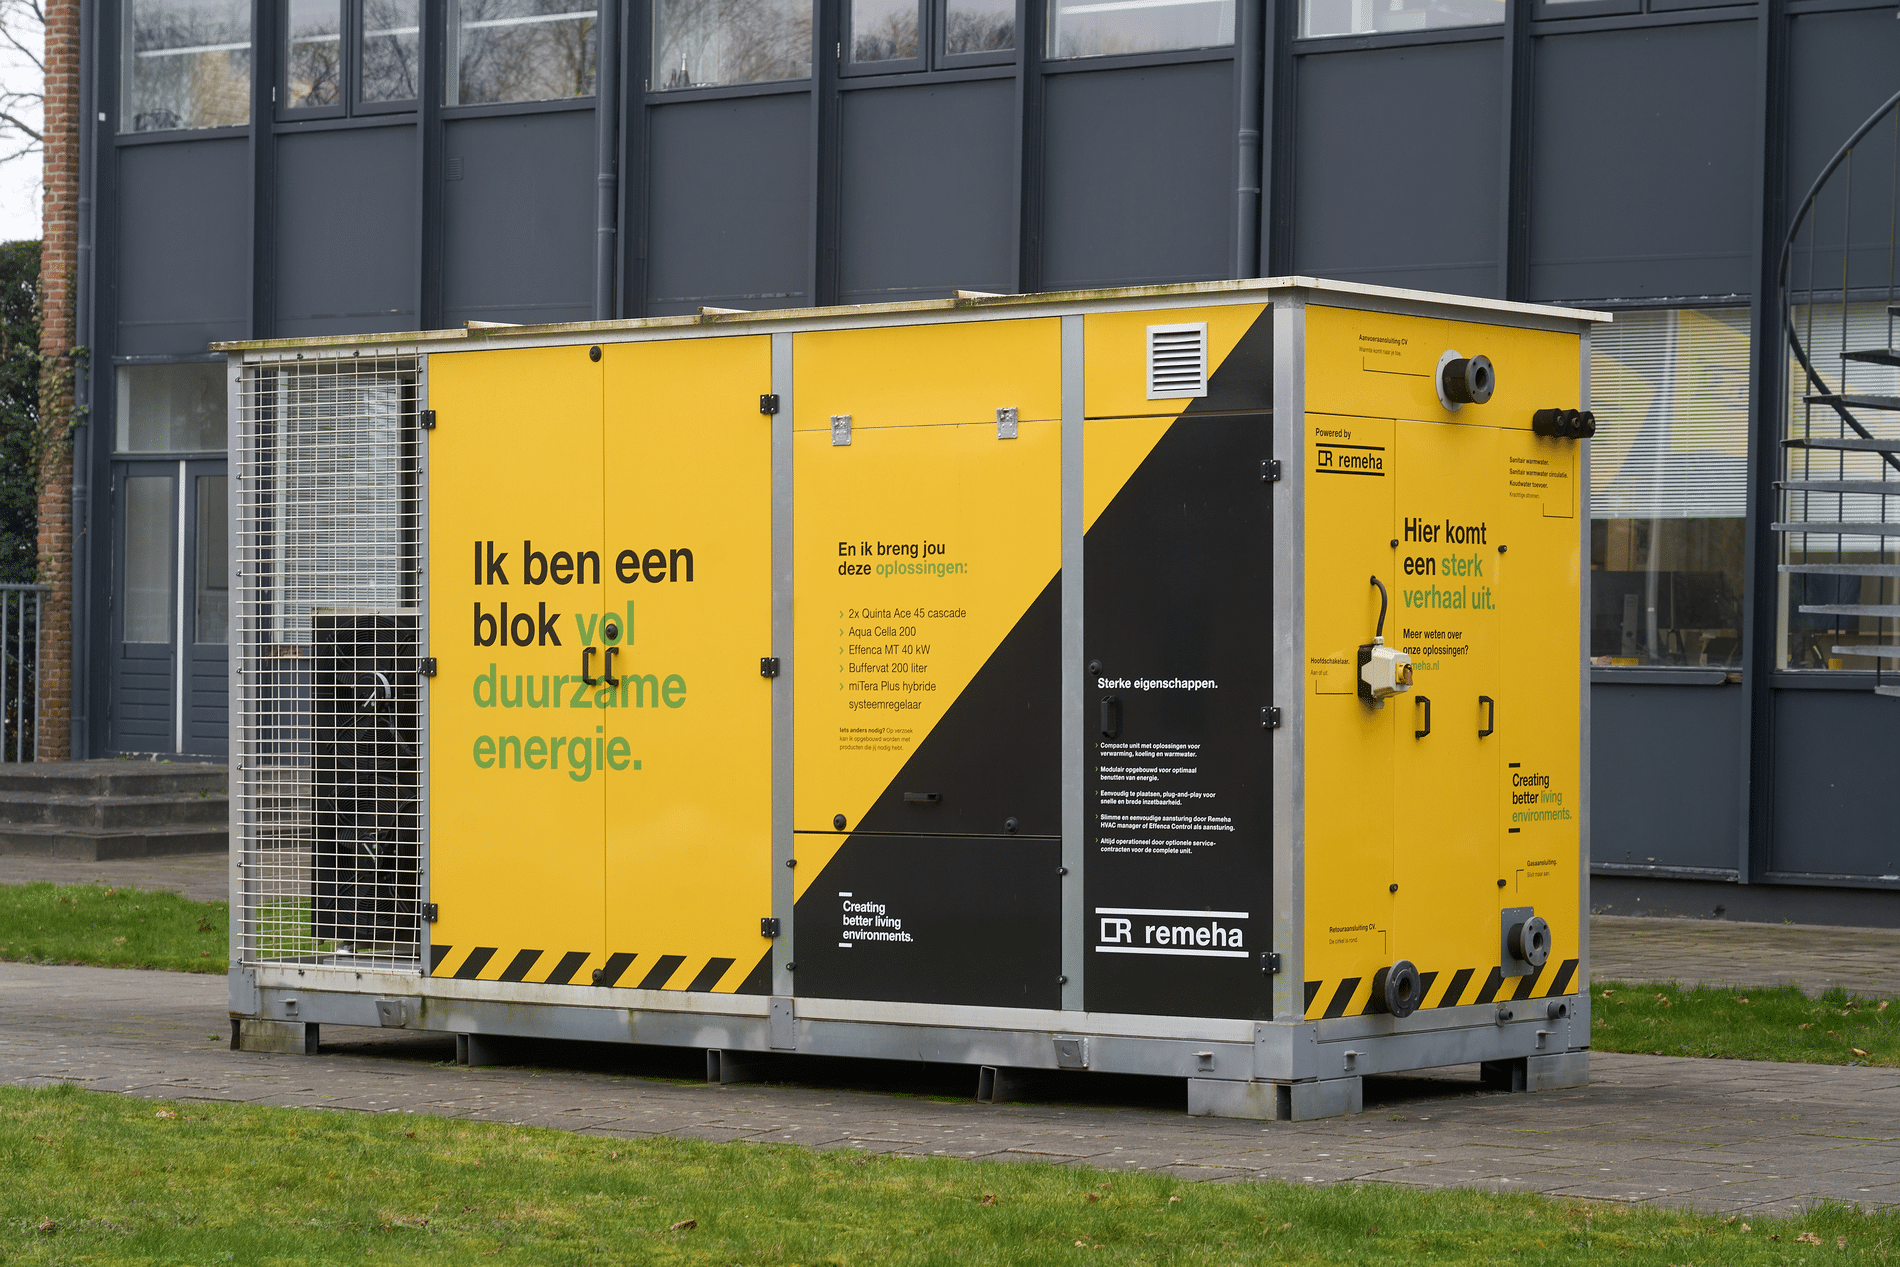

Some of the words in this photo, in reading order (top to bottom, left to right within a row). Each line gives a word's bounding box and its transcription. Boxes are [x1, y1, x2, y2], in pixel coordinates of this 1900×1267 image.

[1315, 427, 1342, 438] Powered
[1344, 429, 1351, 440] by
[1339, 454, 1383, 470] remeha
[1405, 517, 1440, 543] Hier
[1446, 519, 1487, 544] komt
[838, 542, 856, 556] En
[861, 542, 873, 556] ik
[877, 542, 918, 558] breng
[922, 541, 945, 558] jou
[475, 541, 509, 585] Ik
[524, 540, 600, 585] ben
[615, 548, 693, 584] een
[838, 561, 871, 575] deze
[876, 560, 968, 578] oplossingen:
[1404, 556, 1436, 576] een
[1442, 553, 1483, 577] sterk
[1404, 585, 1466, 609] verhaal
[1472, 586, 1495, 610] uit.
[849, 609, 859, 618] 2x
[862, 609, 891, 619] Quinta
[894, 609, 911, 618] Ace
[914, 608, 925, 618] 45
[927, 608, 966, 618] cascade
[474, 602, 562, 646] blok
[575, 600, 634, 646] vol
[849, 627, 872, 639] Aqua
[874, 626, 896, 637] Cella
[899, 626, 916, 636] 200
[1403, 629, 1422, 639] Meer
[1424, 630, 1445, 639] weten
[1447, 631, 1462, 639] over
[849, 645, 882, 655] Effenca
[885, 645, 899, 655] MT
[902, 645, 913, 654] 40
[916, 645, 930, 654] kW
[1403, 646, 1420, 654] onze
[1423, 645, 1469, 657] oplossingen?
[1310, 657, 1350, 665] Hoofdschakelaar.
[1412, 661, 1439, 670] meha.nl
[849, 663, 889, 673] Buffervat
[892, 663, 908, 673] 200
[911, 663, 927, 673] liter
[473, 663, 687, 709] duurzame
[849, 681, 878, 691] miTera
[881, 681, 900, 691] Plus
[903, 681, 936, 693] hybride
[1097, 678, 1131, 689] Sterke
[1134, 678, 1218, 691] eigenschappen.
[849, 700, 922, 711] systeemregelaar
[1100, 742, 1128, 750] Compacte
[473, 725, 641, 782] energie.
[1513, 773, 1550, 789] Creating
[1100, 790, 1129, 798] Eenvoudig
[1513, 791, 1539, 805] better
[1540, 790, 1562, 806] living
[1130, 815, 1161, 823] eenvoudige
[1162, 815, 1192, 823] aansturing
[1512, 807, 1572, 823] environments.
[1203, 824, 1235, 832] aansturing.
[843, 900, 885, 915] Creating
[843, 914, 873, 926] better
[875, 916, 901, 930] living
[843, 929, 913, 942] environments.
[1146, 922, 1243, 947] remeha
